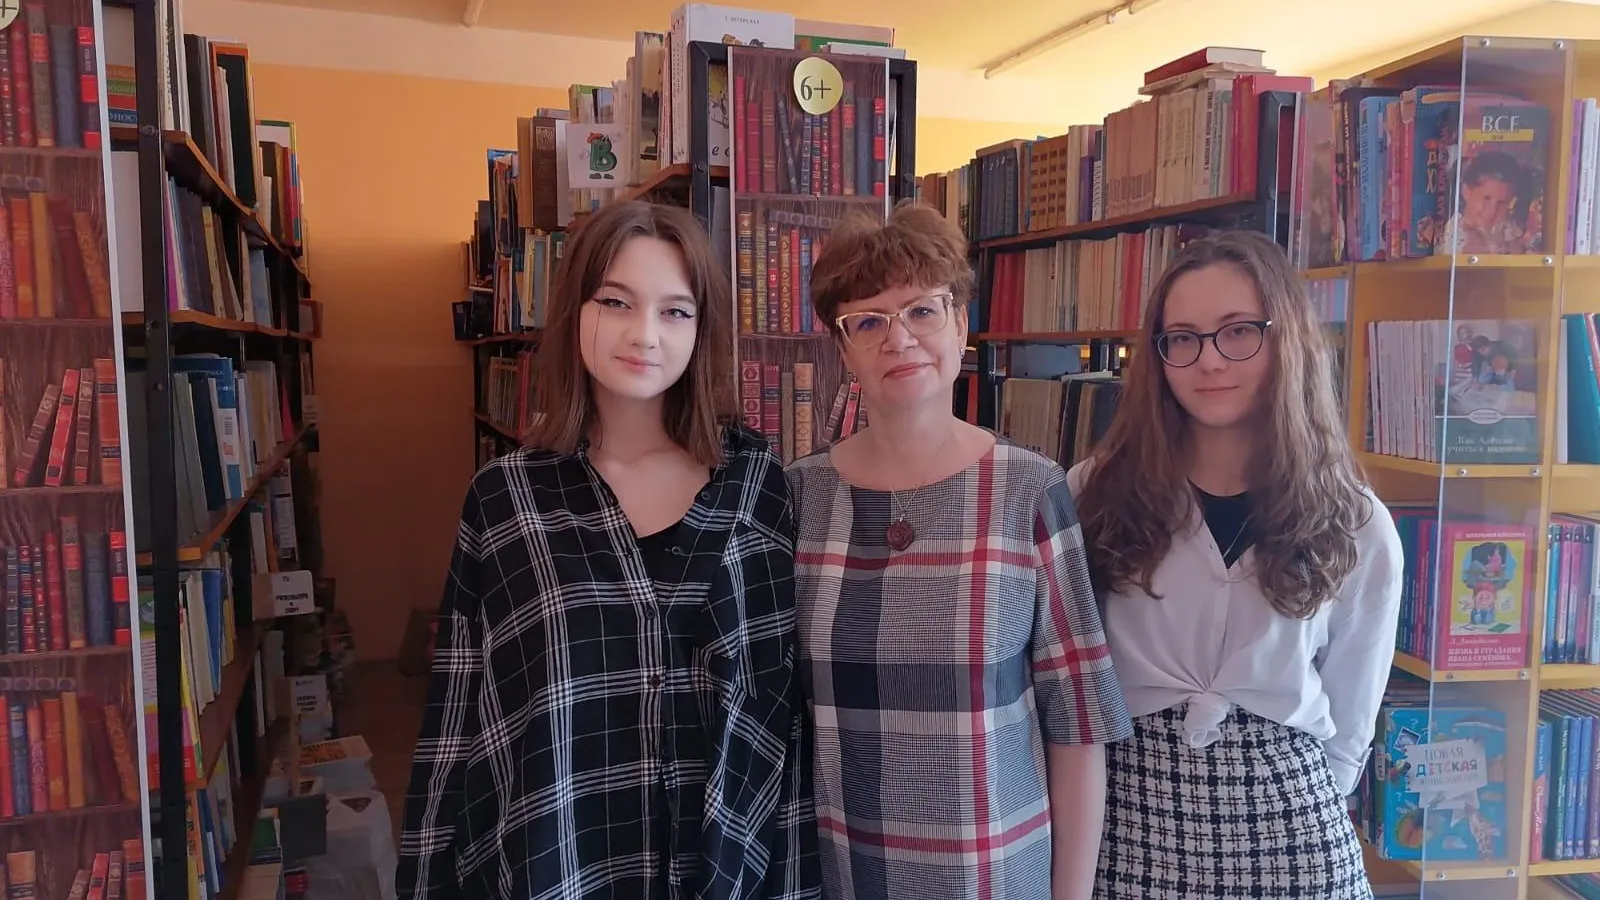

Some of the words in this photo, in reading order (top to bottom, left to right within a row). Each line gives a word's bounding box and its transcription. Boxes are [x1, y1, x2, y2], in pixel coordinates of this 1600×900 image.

[800, 75, 832, 101] 6+
[1482, 114, 1520, 133] ВСЕ
[1416, 759, 1478, 777] ДЕТСКАЯ
